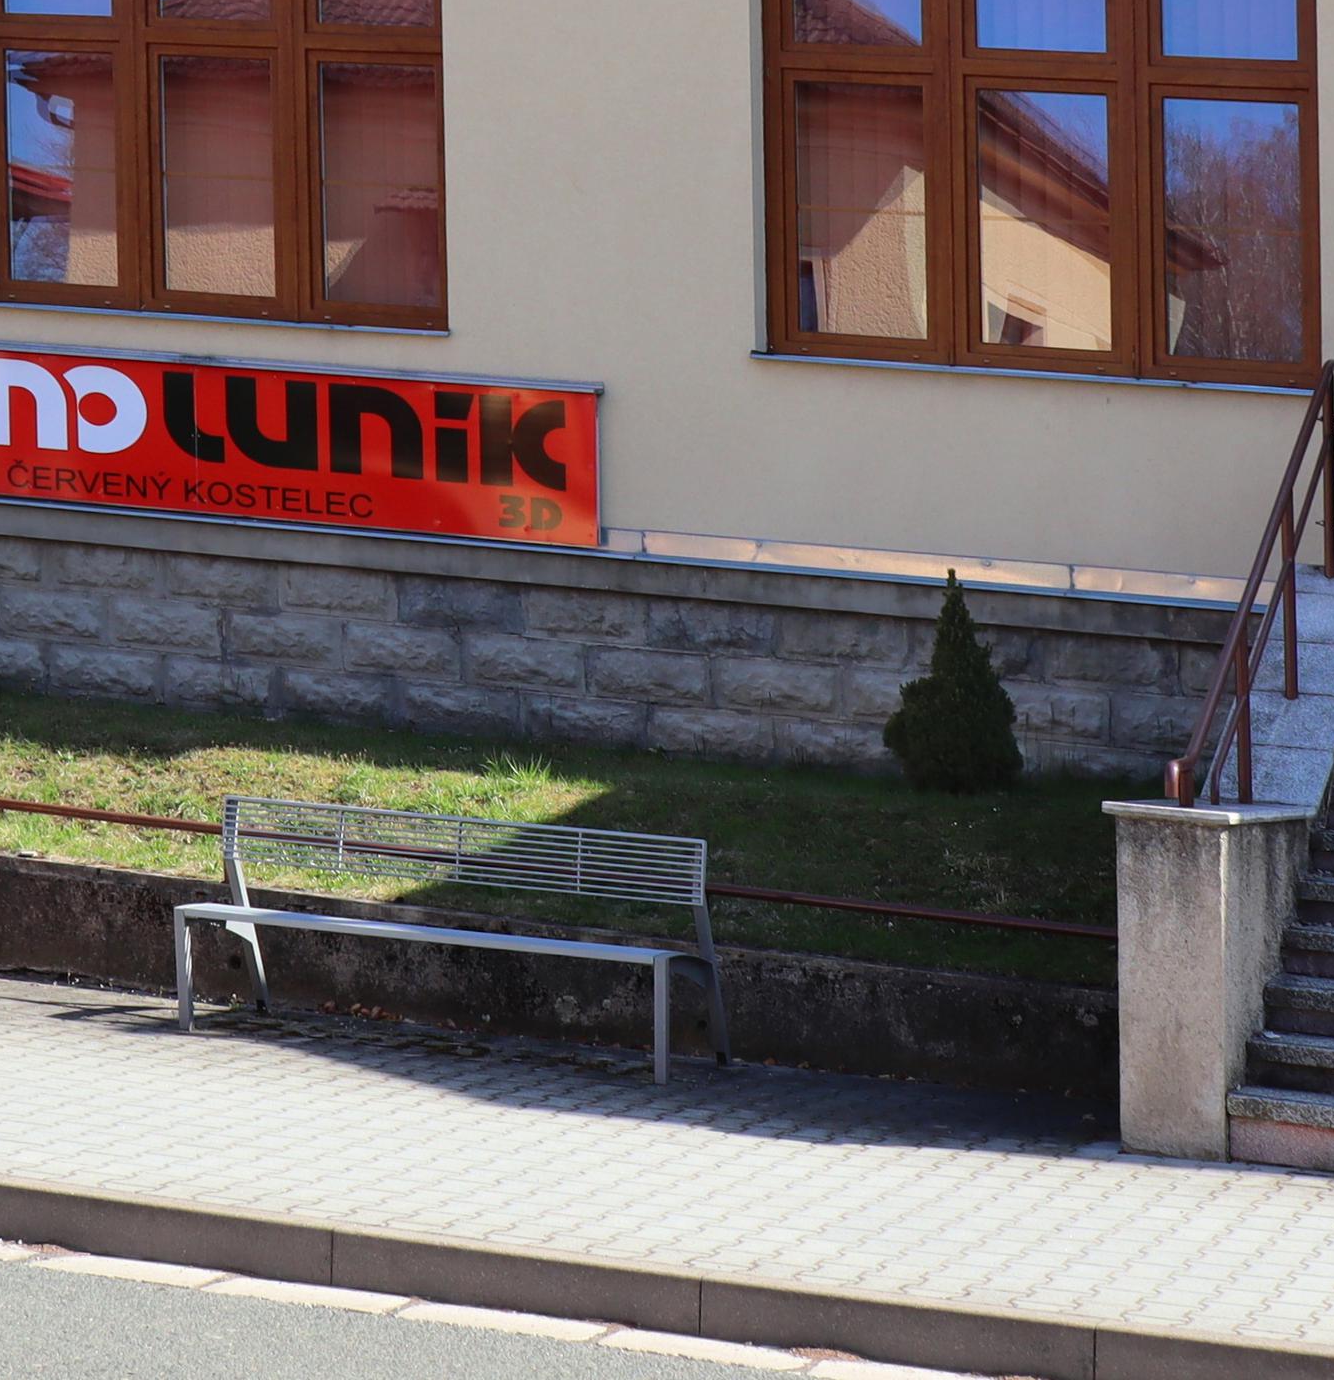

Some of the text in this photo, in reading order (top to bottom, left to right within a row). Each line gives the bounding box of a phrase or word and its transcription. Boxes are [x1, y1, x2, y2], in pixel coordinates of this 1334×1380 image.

[7, 460, 374, 519] ČERVENÝ KOSTELEC
[498, 495, 564, 531] 3D
